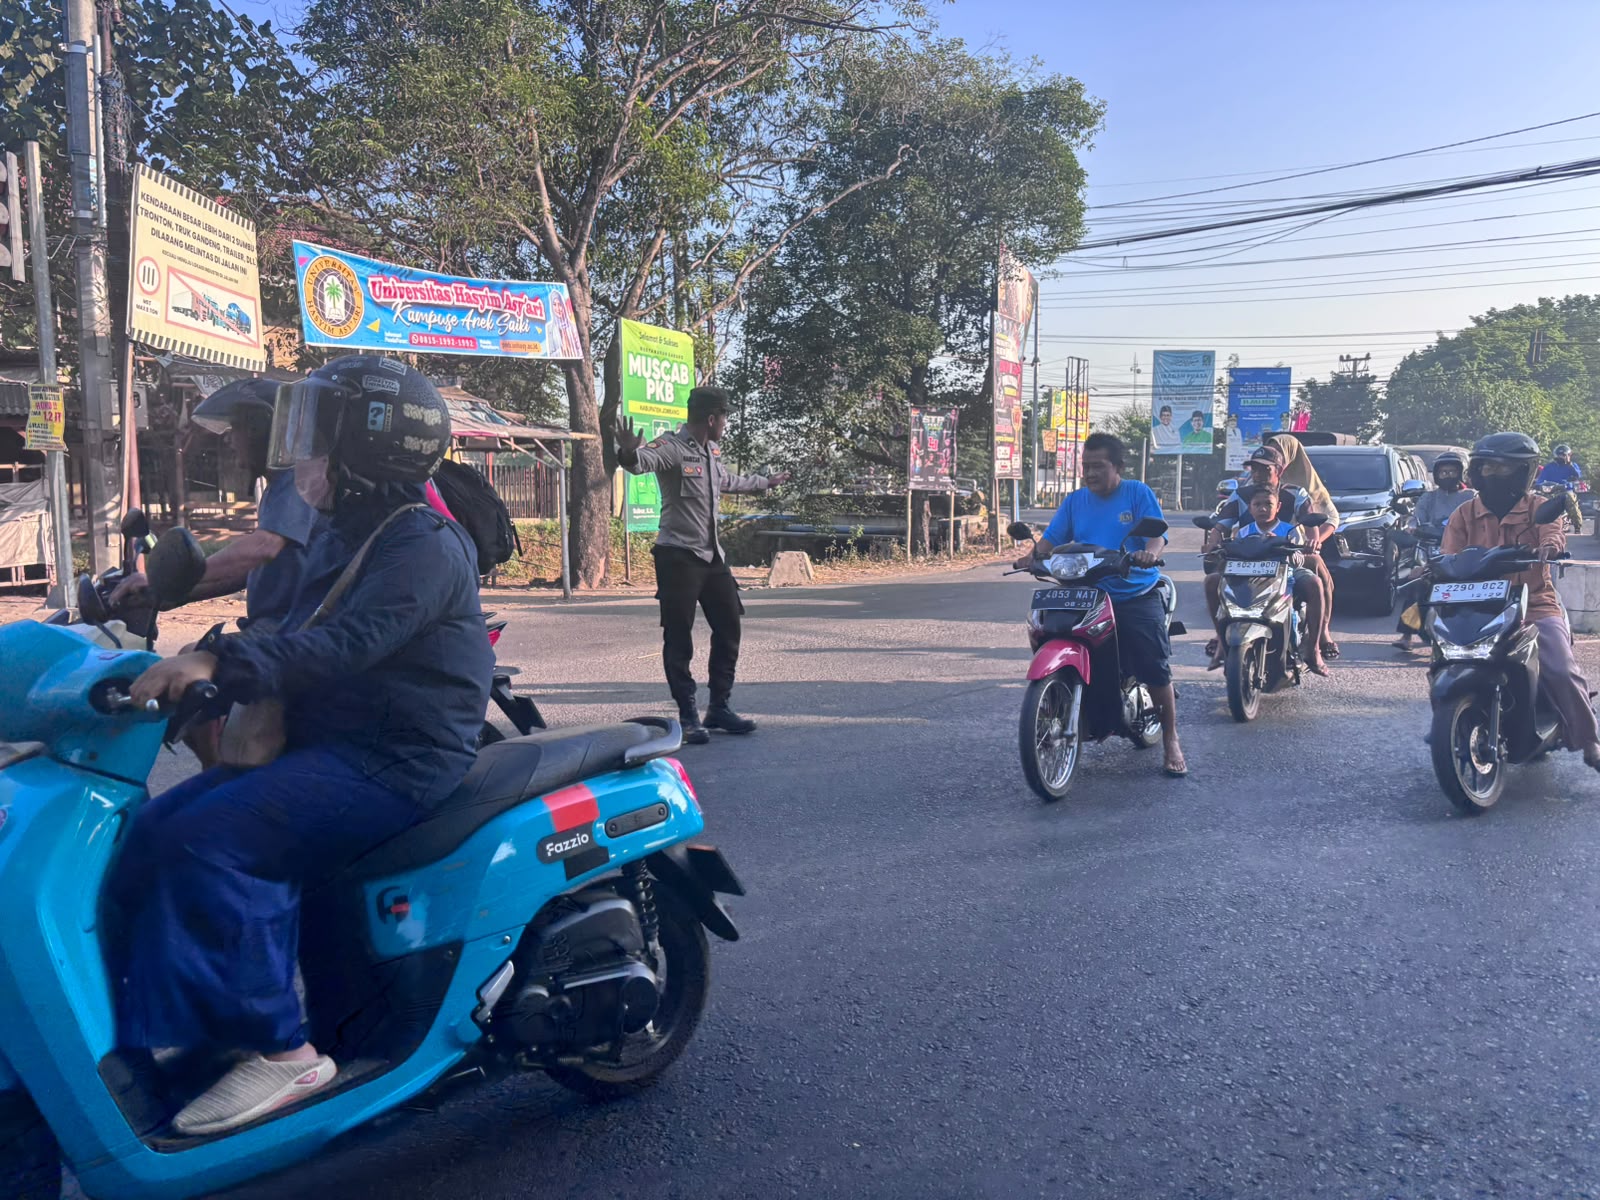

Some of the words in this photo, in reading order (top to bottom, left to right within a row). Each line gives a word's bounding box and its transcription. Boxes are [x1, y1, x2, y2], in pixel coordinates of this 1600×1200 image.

[141, 191, 182, 218] KENDARAAN
[182, 212, 202, 228] BESAR
[202, 221, 218, 236] LEBIH
[218, 229, 231, 242] DARI
[236, 238, 255, 252] SUMBU
[175, 222, 191, 238] TRUK
[151, 227, 184, 249] DILARANG
[184, 242, 213, 262] MELINTAS
[214, 255, 221, 265] DI
[221, 258, 239, 272] JALAN
[369, 278, 453, 304] Universitas
[453, 284, 502, 313] Hasyim
[503, 291, 546, 319] Asy'ari
[391, 301, 459, 333] Kampuse
[496, 313, 530, 336] Saiki
[628, 352, 689, 386] MUSCAB
[646, 378, 674, 403] PKB
[1035, 591, 1041, 600] S
[1076, 590, 1096, 599] NAT
[1446, 583, 1474, 592] 2290
[546, 833, 589, 857] Fazzio
